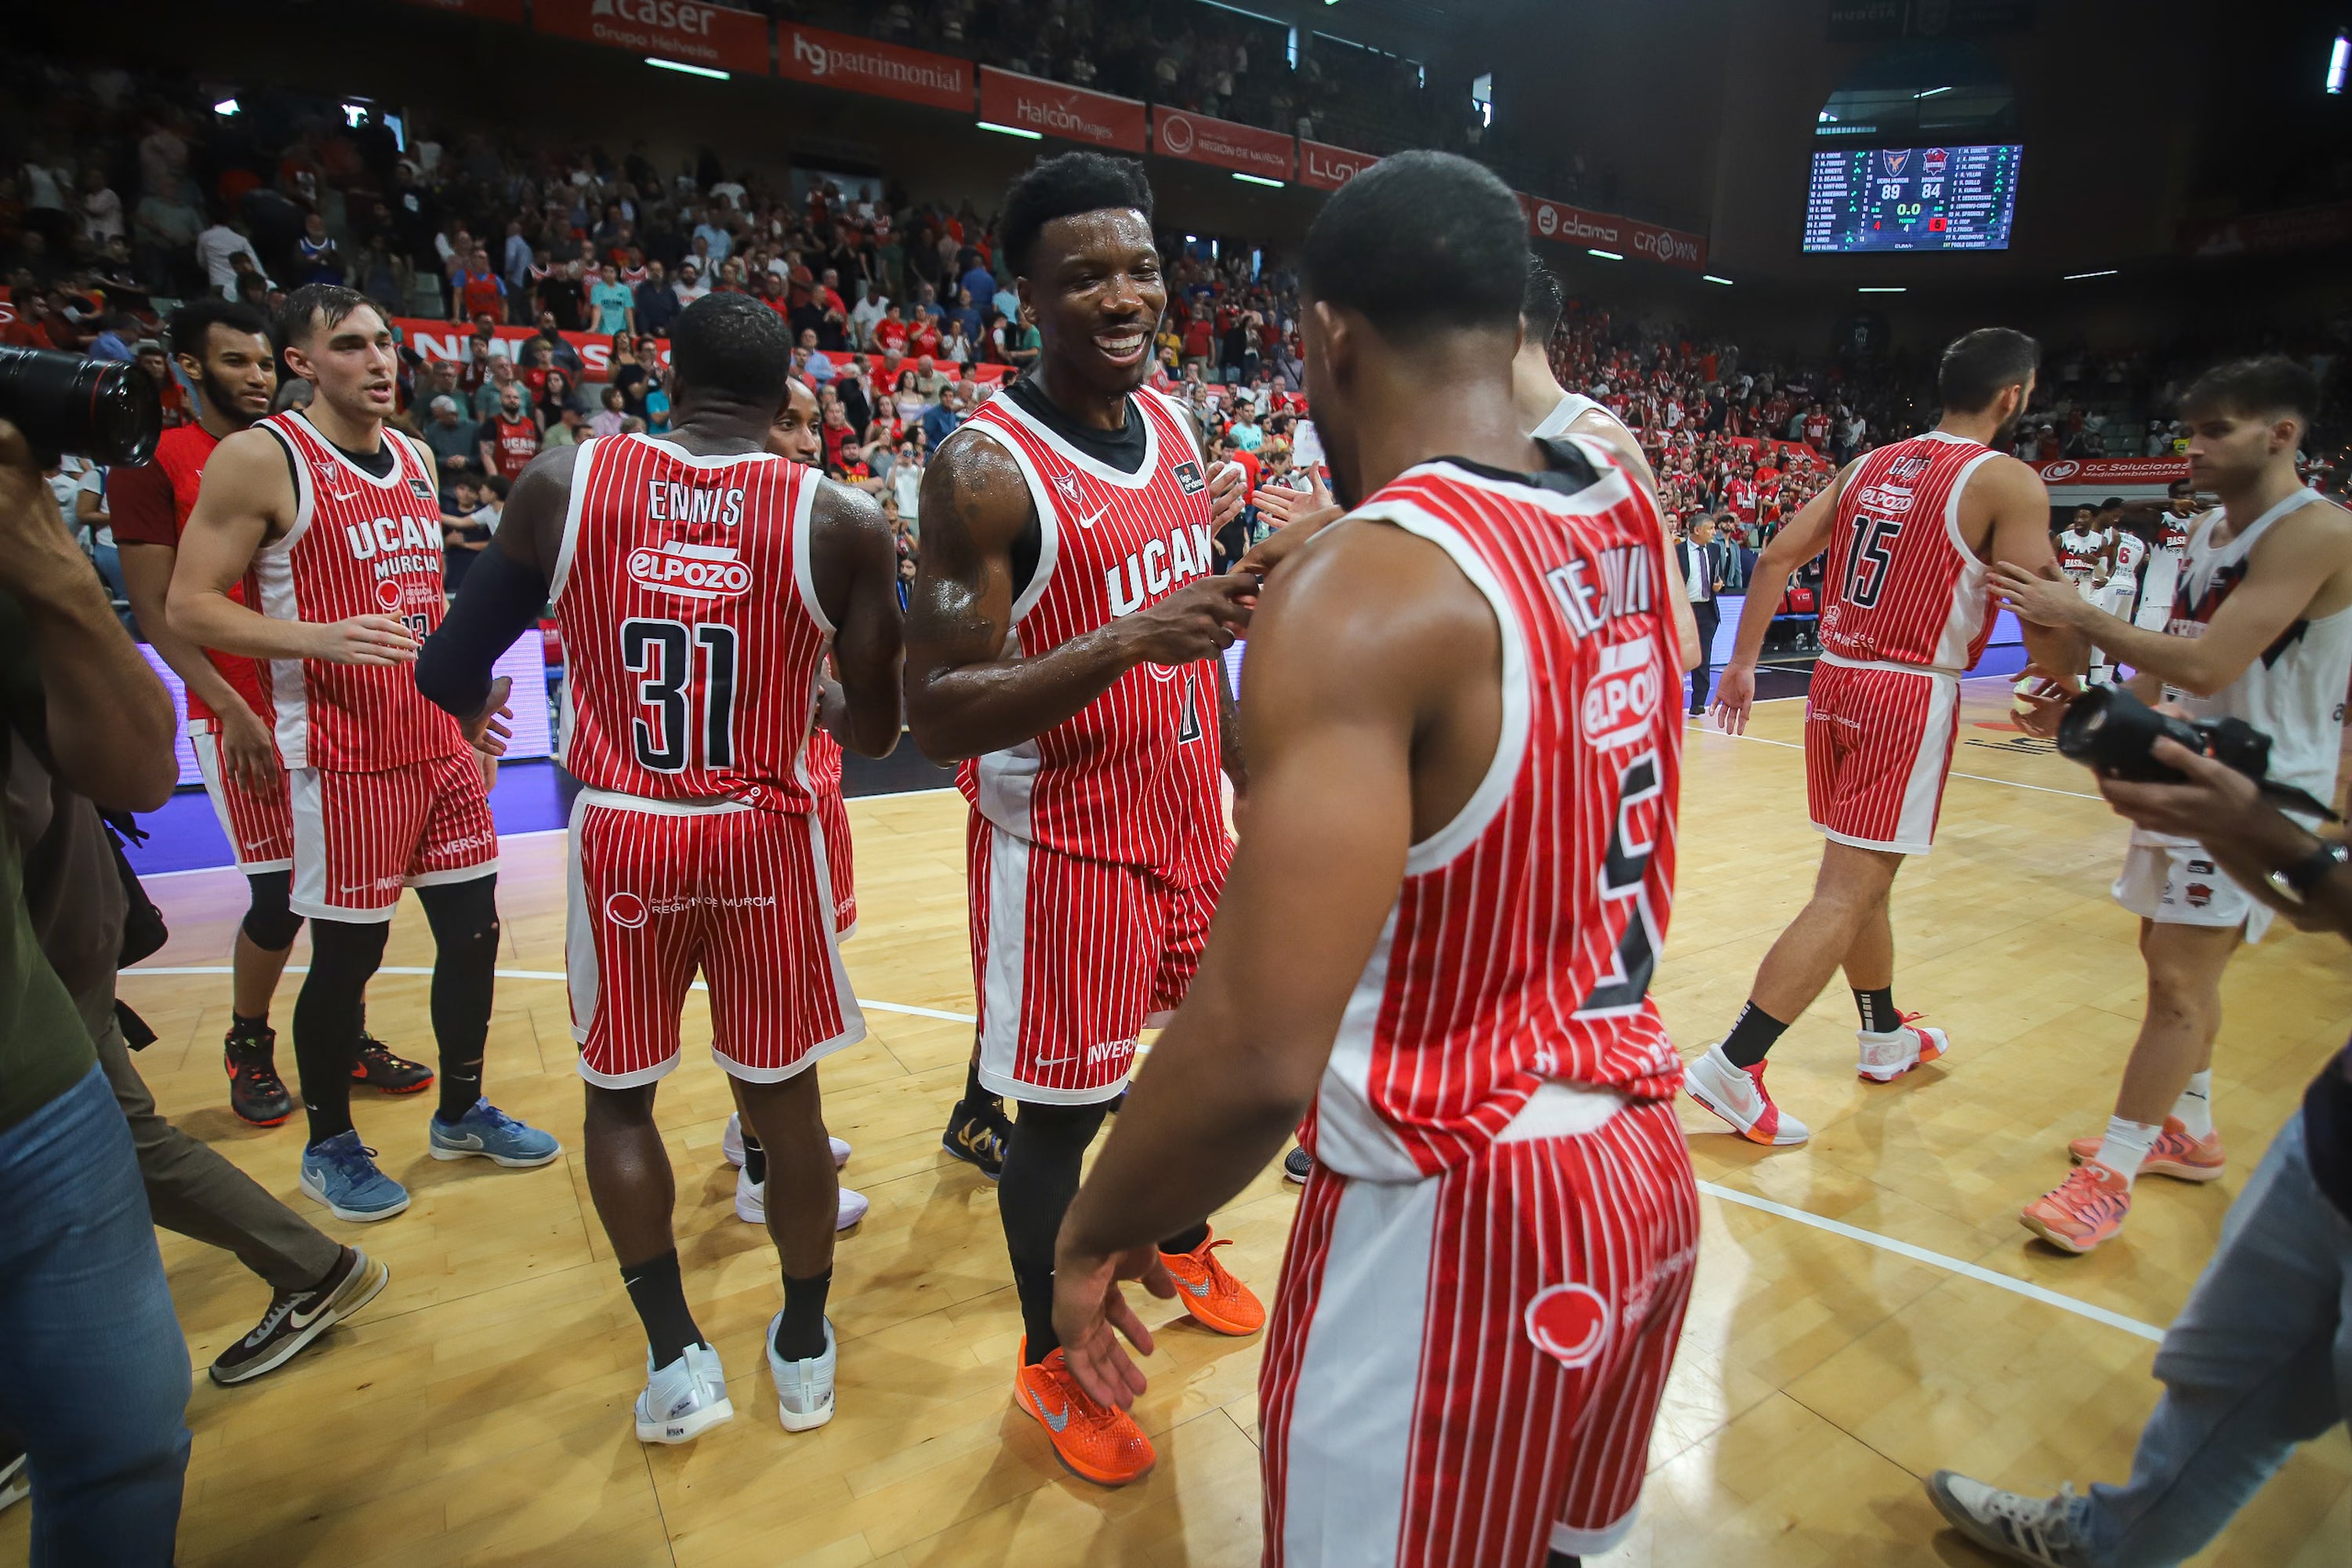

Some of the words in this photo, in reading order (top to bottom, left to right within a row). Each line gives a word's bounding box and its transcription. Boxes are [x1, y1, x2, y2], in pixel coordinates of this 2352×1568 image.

[1250, 150, 1285, 167] MURCIA
[1882, 184, 1900, 200] 89
[1922, 183, 1940, 198] 84
[1897, 203, 1921, 216] 0.0
[1563, 215, 1617, 241] dama
[1874, 220, 1880, 230] 4
[1904, 224, 1909, 233] 4
[2109, 463, 2190, 471] Soluciones
[648, 480, 744, 527] ENNIS
[347, 514, 444, 561] UCAM
[1842, 514, 1903, 609] 15
[2118, 547, 2131, 564] 6
[374, 554, 440, 581] MURCIA
[407, 597, 418, 605] DE
[419, 595, 441, 605] MURC
[621, 617, 740, 774] 31
[721, 895, 777, 908] MURCIA
